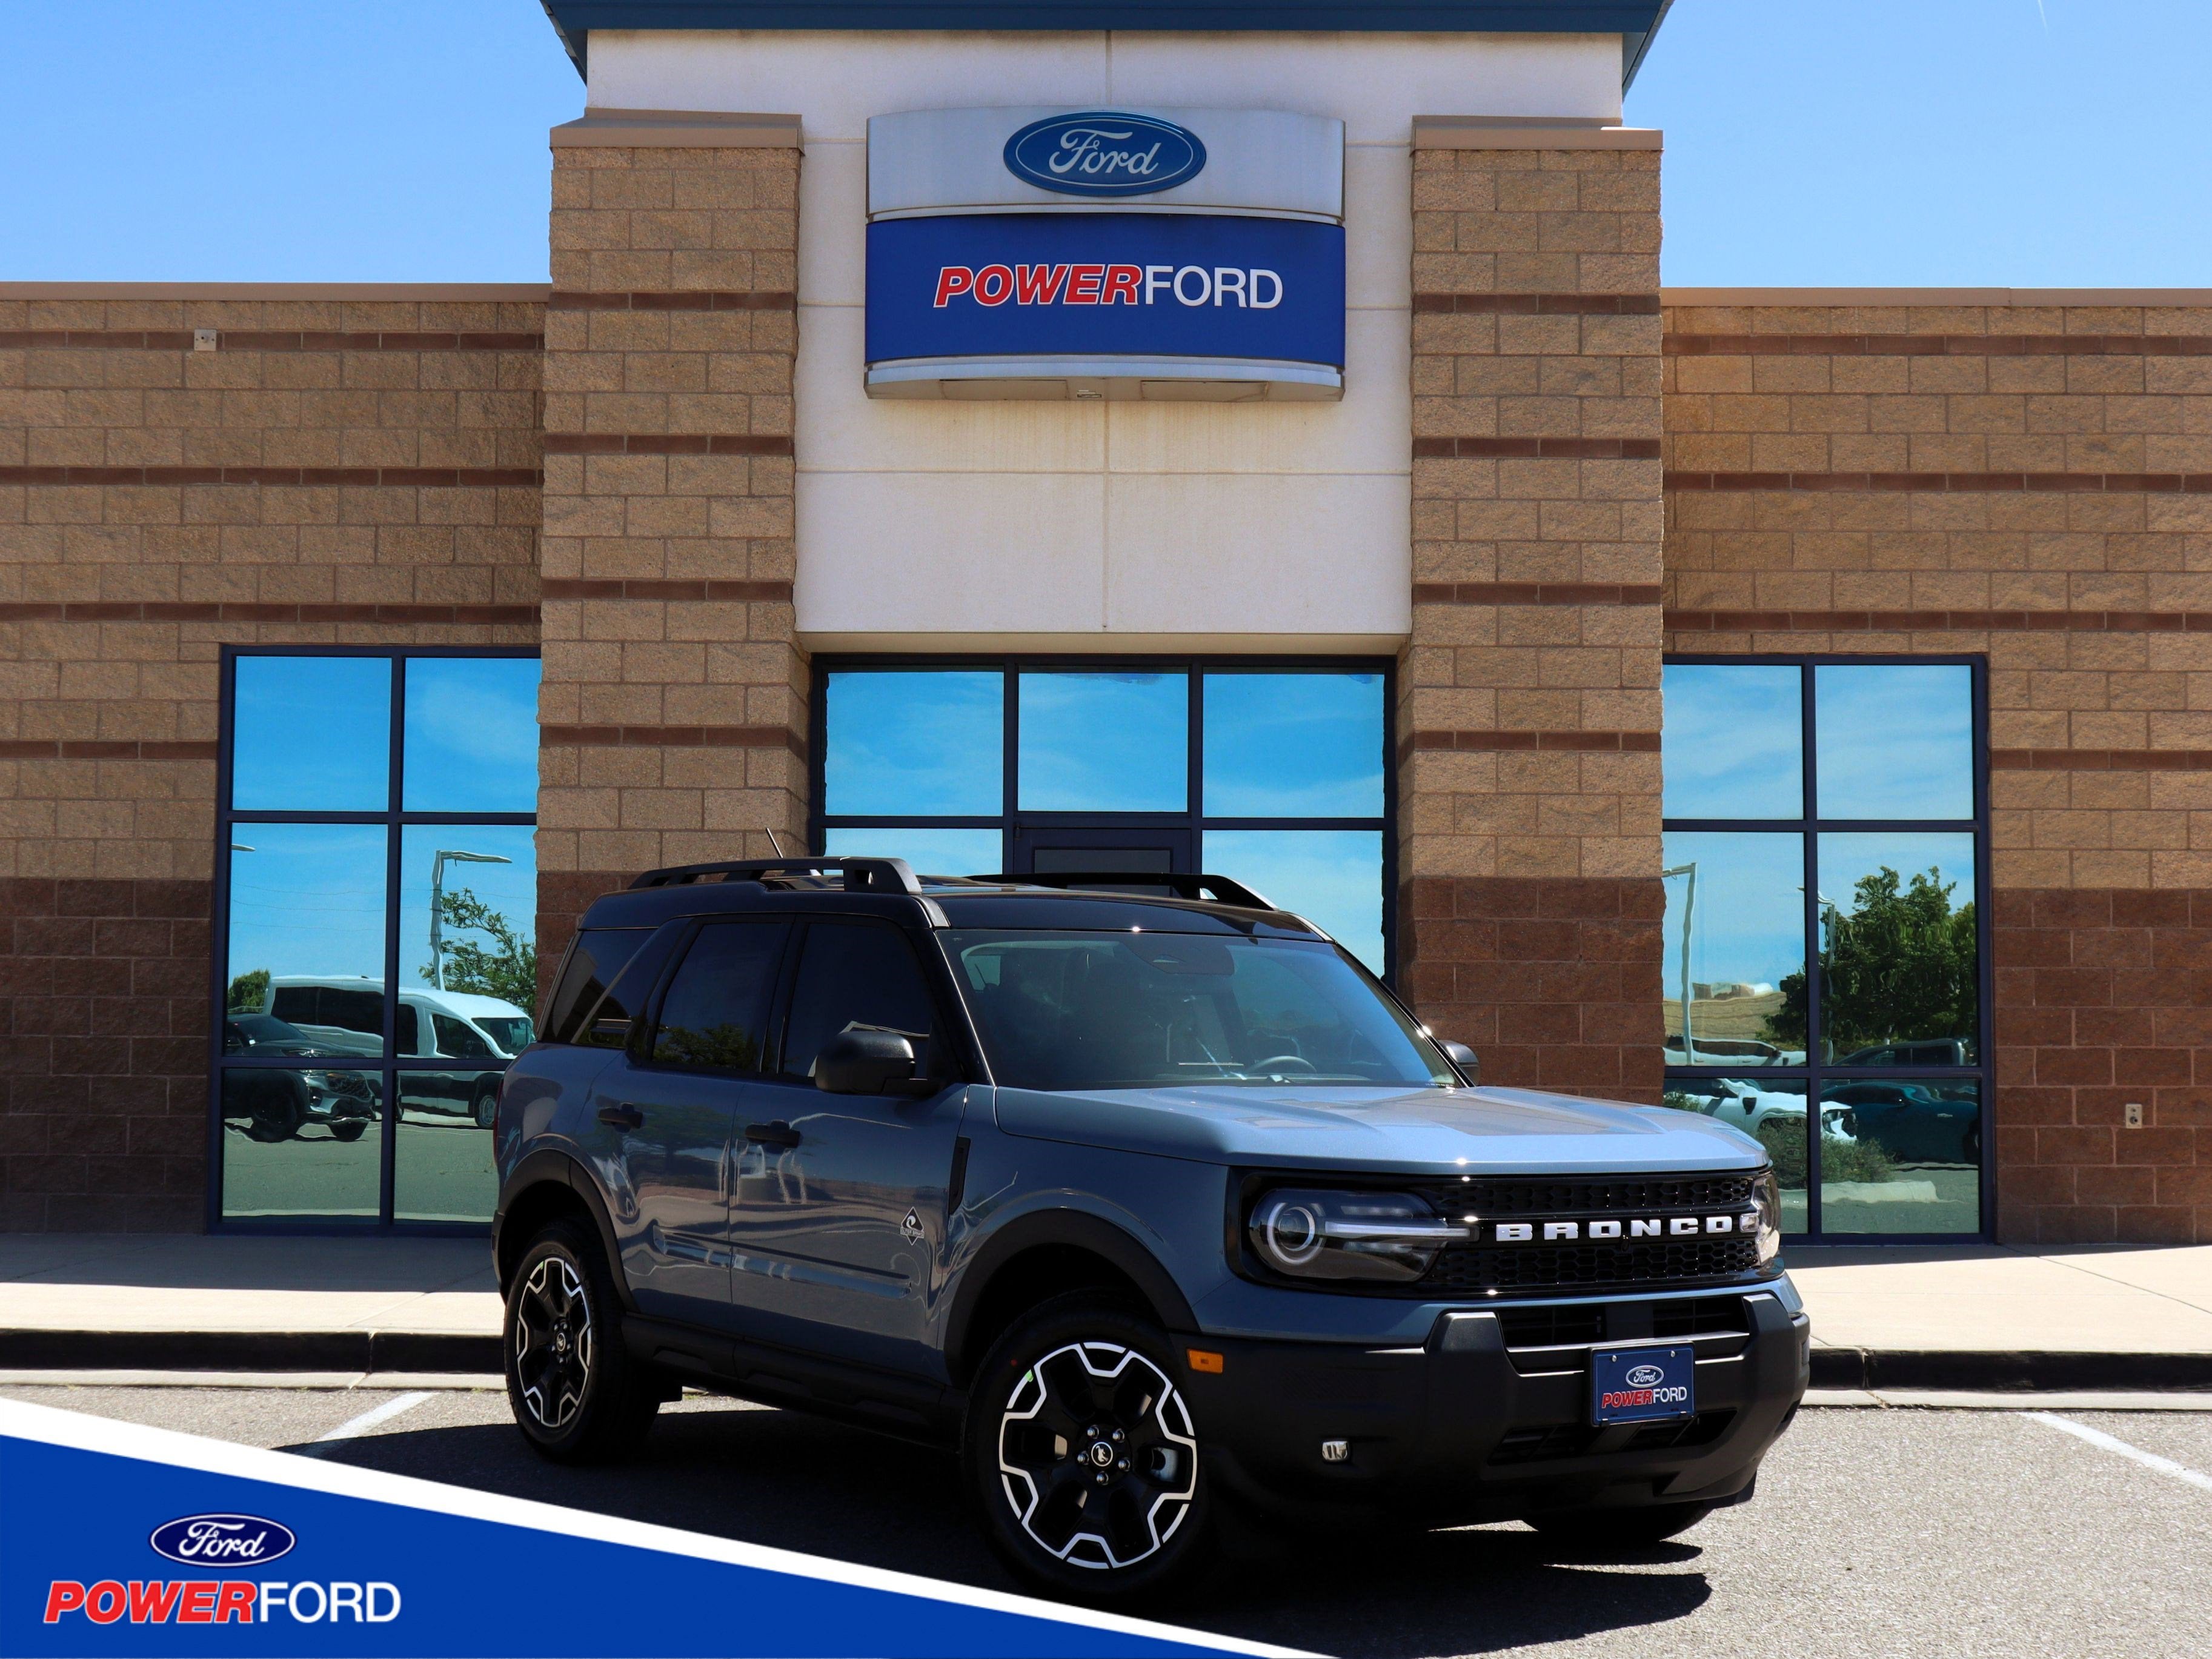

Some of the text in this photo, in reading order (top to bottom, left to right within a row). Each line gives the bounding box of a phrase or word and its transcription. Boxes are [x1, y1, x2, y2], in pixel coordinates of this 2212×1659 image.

[1049, 128, 1161, 175] Ford
[1496, 1218, 1732, 1242] BRONCO
[1633, 1369, 1656, 1383] Ford
